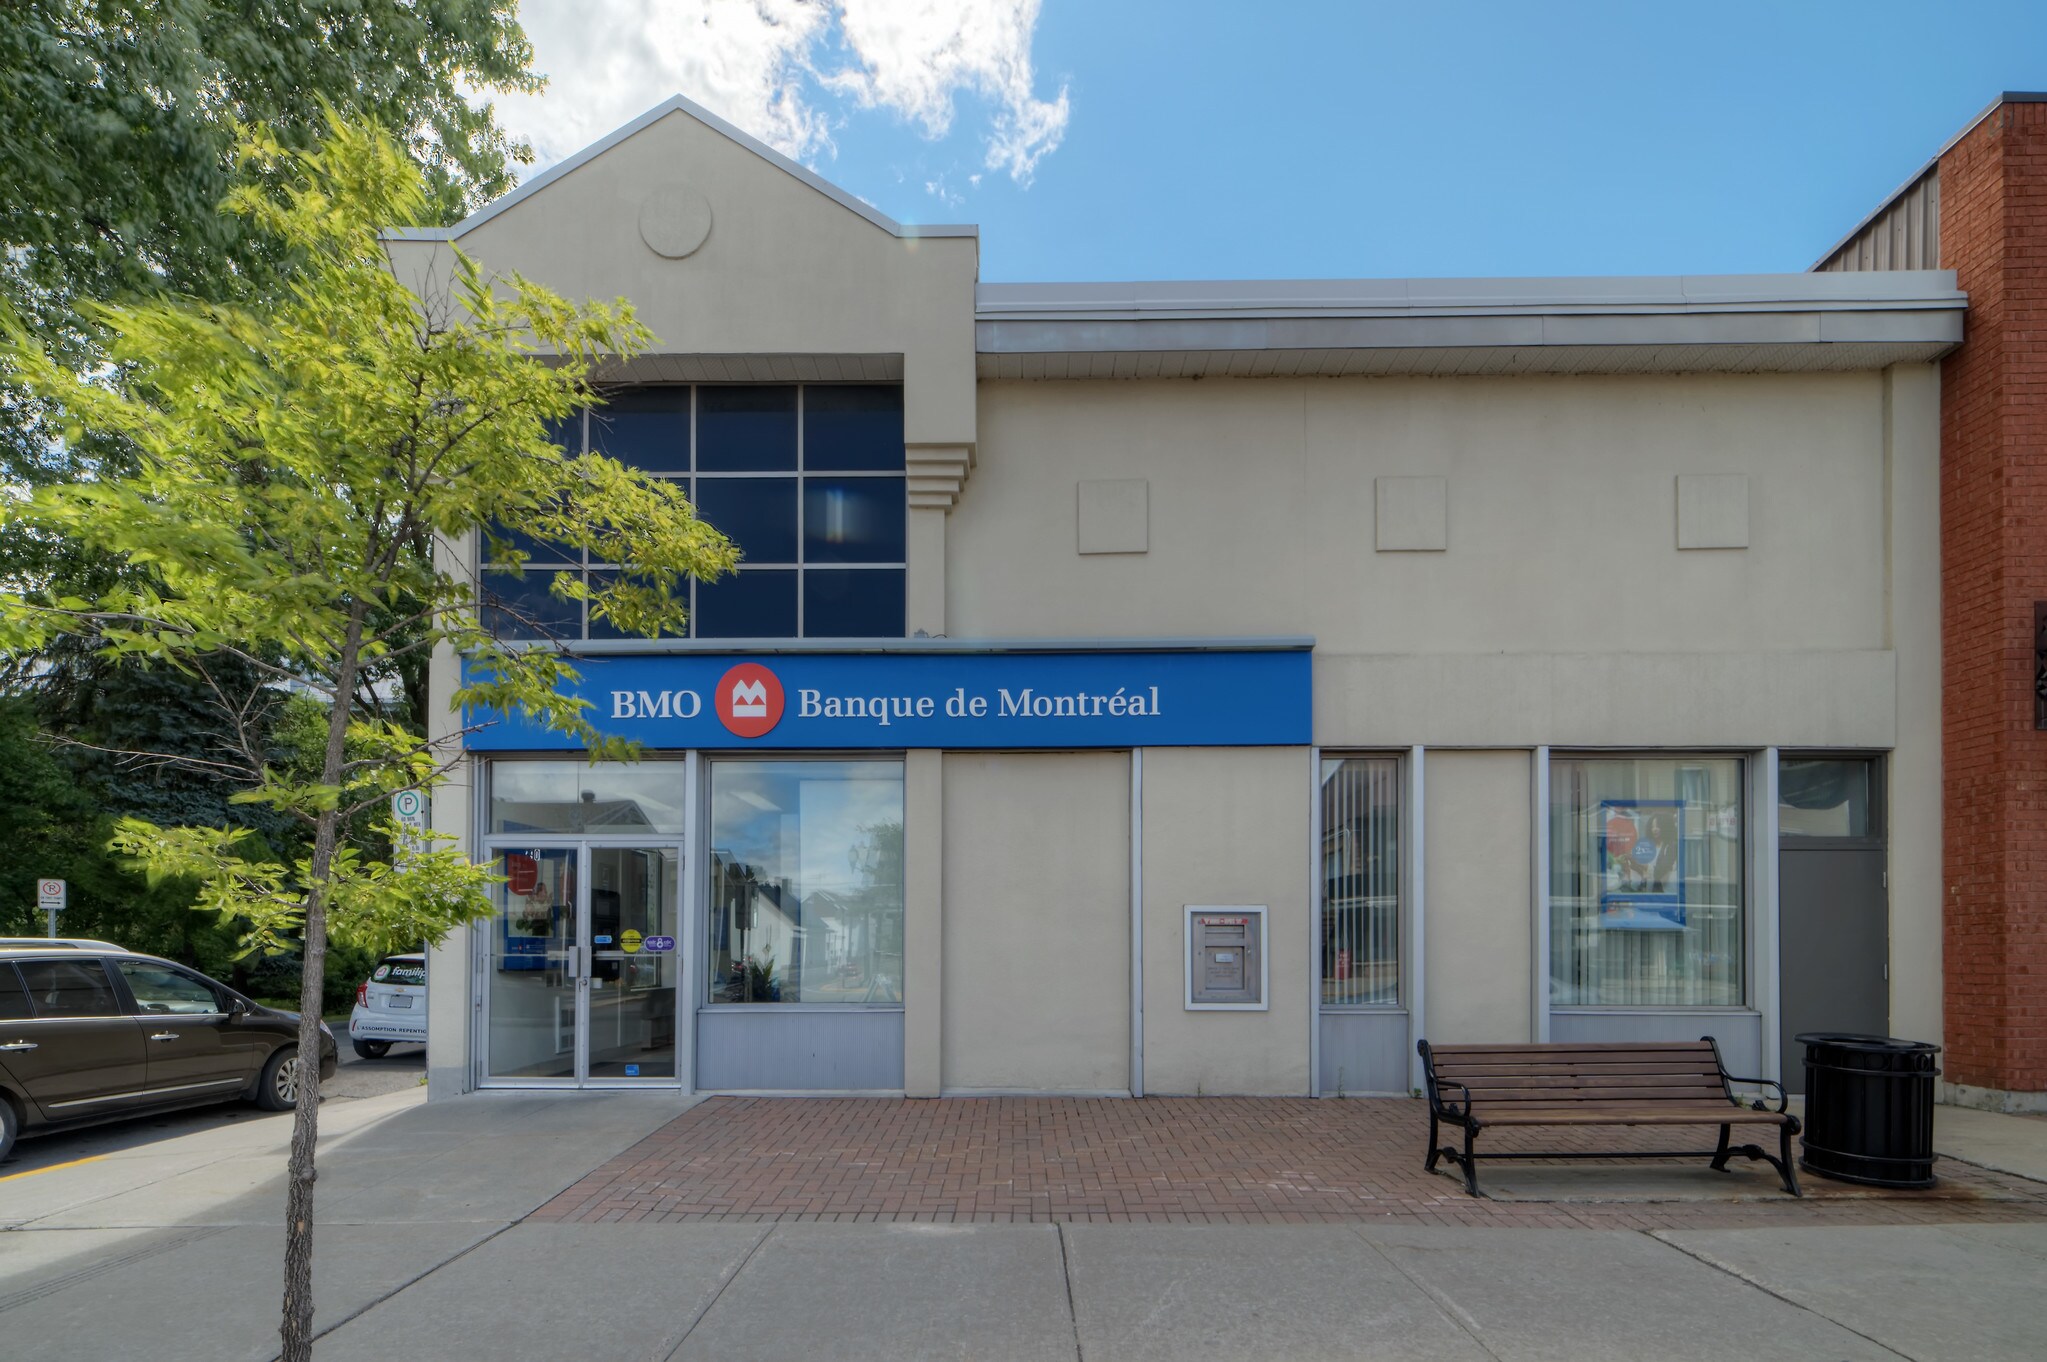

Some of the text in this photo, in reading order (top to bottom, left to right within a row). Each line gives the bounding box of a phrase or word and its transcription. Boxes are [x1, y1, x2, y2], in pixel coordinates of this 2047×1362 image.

[610, 690, 702, 719] BMO
[798, 686, 1162, 727] Banque de Montréal
[404, 798, 412, 810] P
